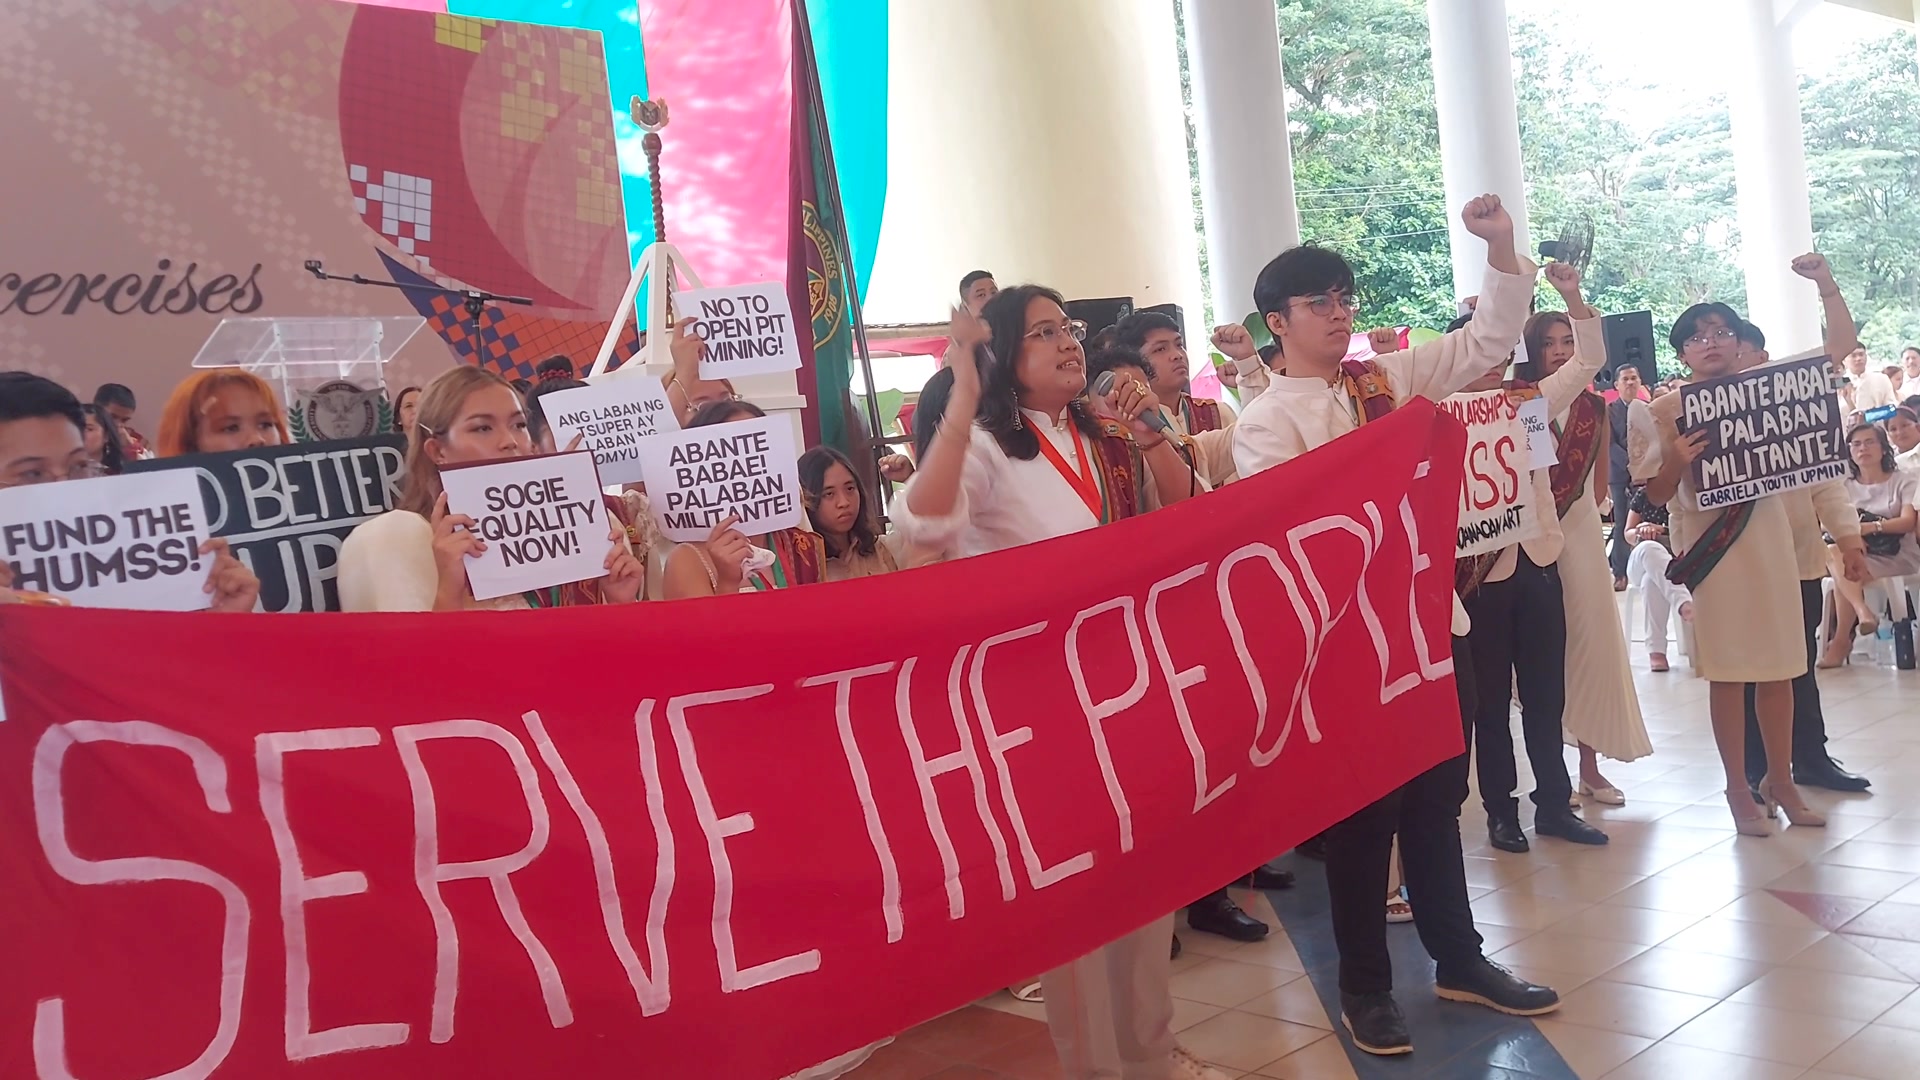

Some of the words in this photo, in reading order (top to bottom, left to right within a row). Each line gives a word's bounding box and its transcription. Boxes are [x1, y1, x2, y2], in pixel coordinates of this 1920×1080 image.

[700, 298, 735, 318] NO
[737, 295, 769, 314] TO
[824, 294, 838, 325] 1908
[693, 317, 752, 341] OPEN
[755, 314, 785, 335] PIT
[704, 336, 784, 363] MINING!
[1685, 376, 1771, 428] ABANTE
[1773, 361, 1838, 405] BABAE
[560, 411, 591, 427] ANG
[593, 402, 642, 420] LABAN
[644, 399, 664, 412] NG
[576, 418, 634, 438] TSUPER
[638, 414, 655, 428] AY
[1719, 400, 1828, 449] PALABAN
[586, 433, 636, 451] LABAN
[595, 447, 639, 465] OMYU
[669, 431, 770, 467] ABANTE
[1702, 428, 1840, 489] MILITANTE!
[233, 446, 403, 530] BETTER
[676, 455, 768, 488] BABAE!
[1700, 483, 1760, 507] GABRIELA
[1762, 474, 1797, 493] YOUTH
[1801, 463, 1845, 483] UPMIN
[485, 477, 569, 512] SOGIE
[666, 474, 784, 511] PALABAN
[664, 493, 792, 529] MILITANTE!
[1503, 505, 1526, 533] ART
[3, 513, 117, 556] FUND
[122, 503, 196, 540] THE
[11, 537, 201, 593] HUMSS!
[500, 531, 581, 567] NOW!
[32, 684, 822, 1080] SERVE
[797, 621, 1095, 943] THE
[1065, 460, 1454, 853] PEOPLE
